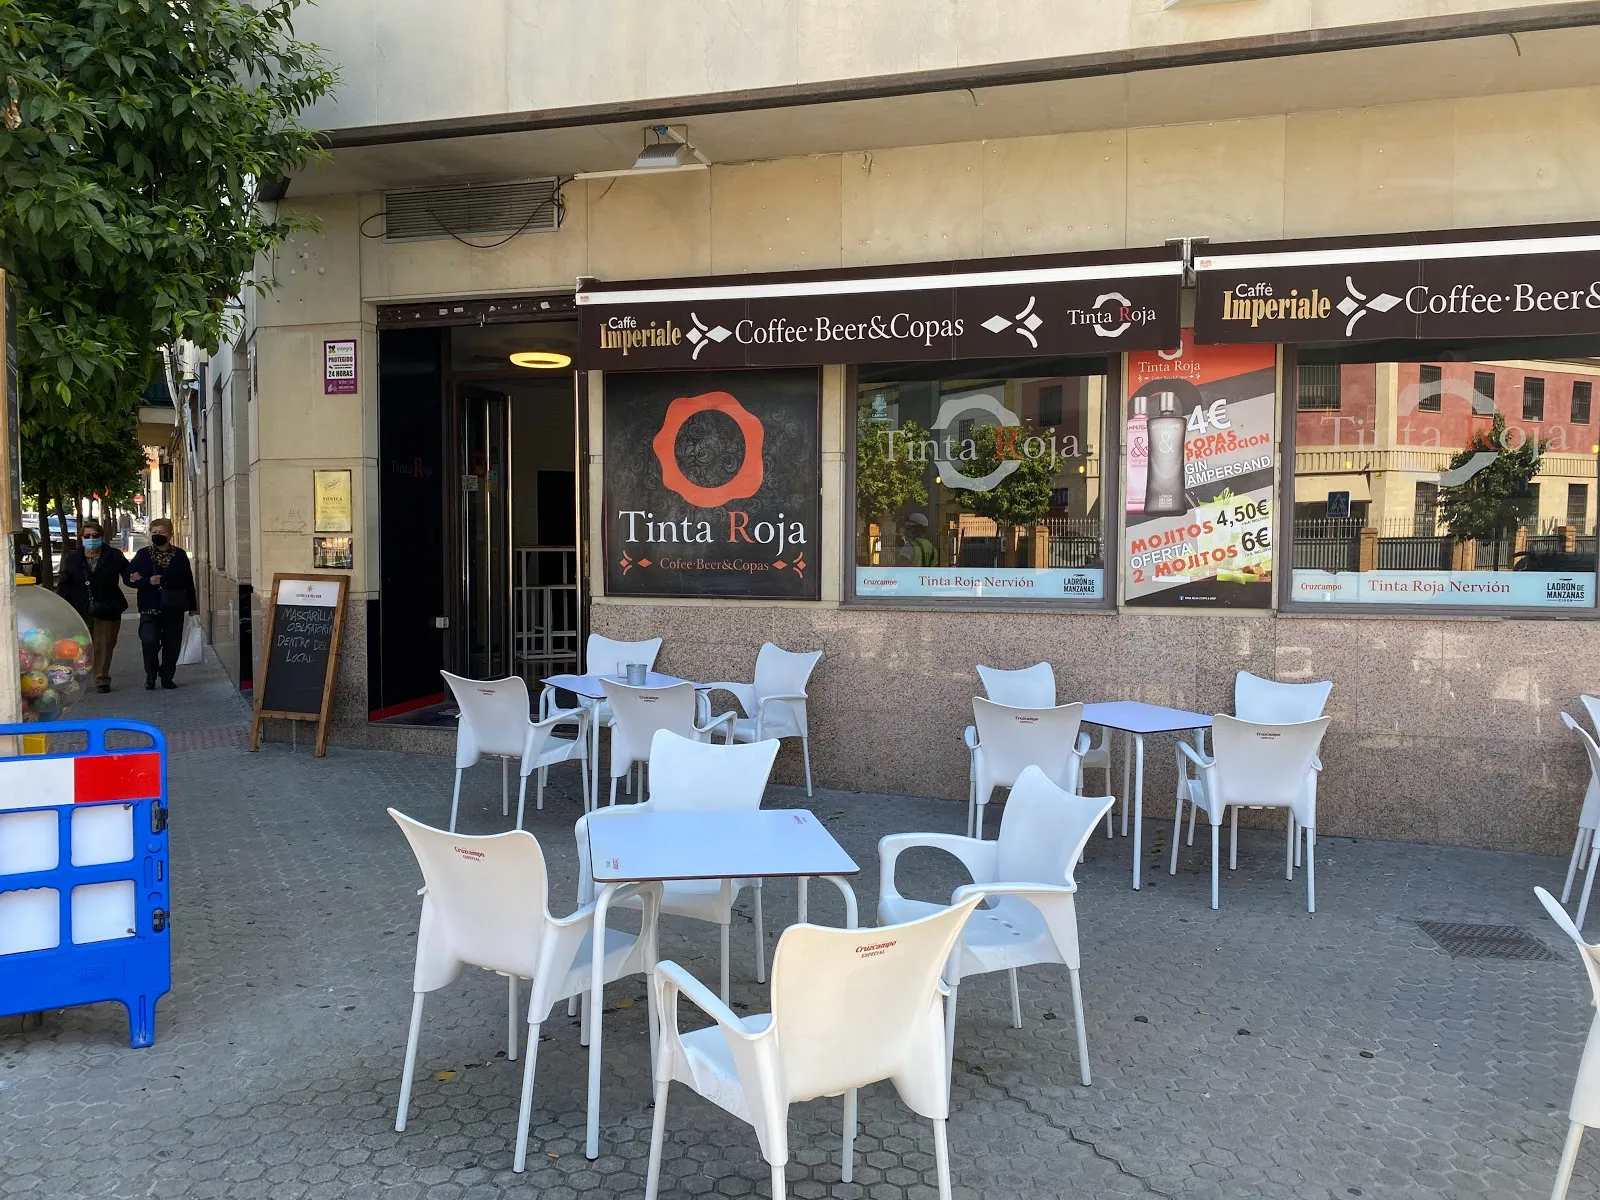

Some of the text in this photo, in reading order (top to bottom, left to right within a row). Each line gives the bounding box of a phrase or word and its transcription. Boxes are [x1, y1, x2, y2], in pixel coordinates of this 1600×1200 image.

[1235, 283, 1273, 298] Caffè
[1067, 306, 1156, 327] Tinta Roja
[1222, 289, 1331, 328] Imperiale
[608, 316, 637, 329] Caffè
[599, 320, 682, 356] Imperiale
[1137, 361, 1201, 374] Tinta Roja
[1187, 399, 1232, 434] 4€
[877, 426, 1083, 471] Tinta Roja
[1185, 430, 1237, 451] COPAS
[1185, 433, 1270, 461] PROMOCION
[1321, 414, 1571, 465] Tinta Roja
[1185, 459, 1208, 475] GIN
[1187, 455, 1271, 487] AMPERSAND
[1216, 499, 1269, 527] 4,50€
[618, 510, 807, 556] Tinta Roja
[1131, 520, 1214, 554] MOJITOS
[1241, 527, 1271, 552] 6€
[1130, 542, 1193, 570] OFERTA
[1133, 544, 1238, 584] 2 MOJITOS
[863, 578, 898, 587] Cruzcampo
[918, 575, 1035, 590] Tinta Roja Nervión
[1063, 577, 1087, 586] LADRÓN
[1301, 582, 1342, 591] Cruzcampo
[1368, 579, 1511, 596] Tinta Roja Nervión
[1547, 582, 1576, 591] LADRÓN
[277, 635, 327, 651] DENTRO DEL
[286, 649, 312, 663] LOCAL
